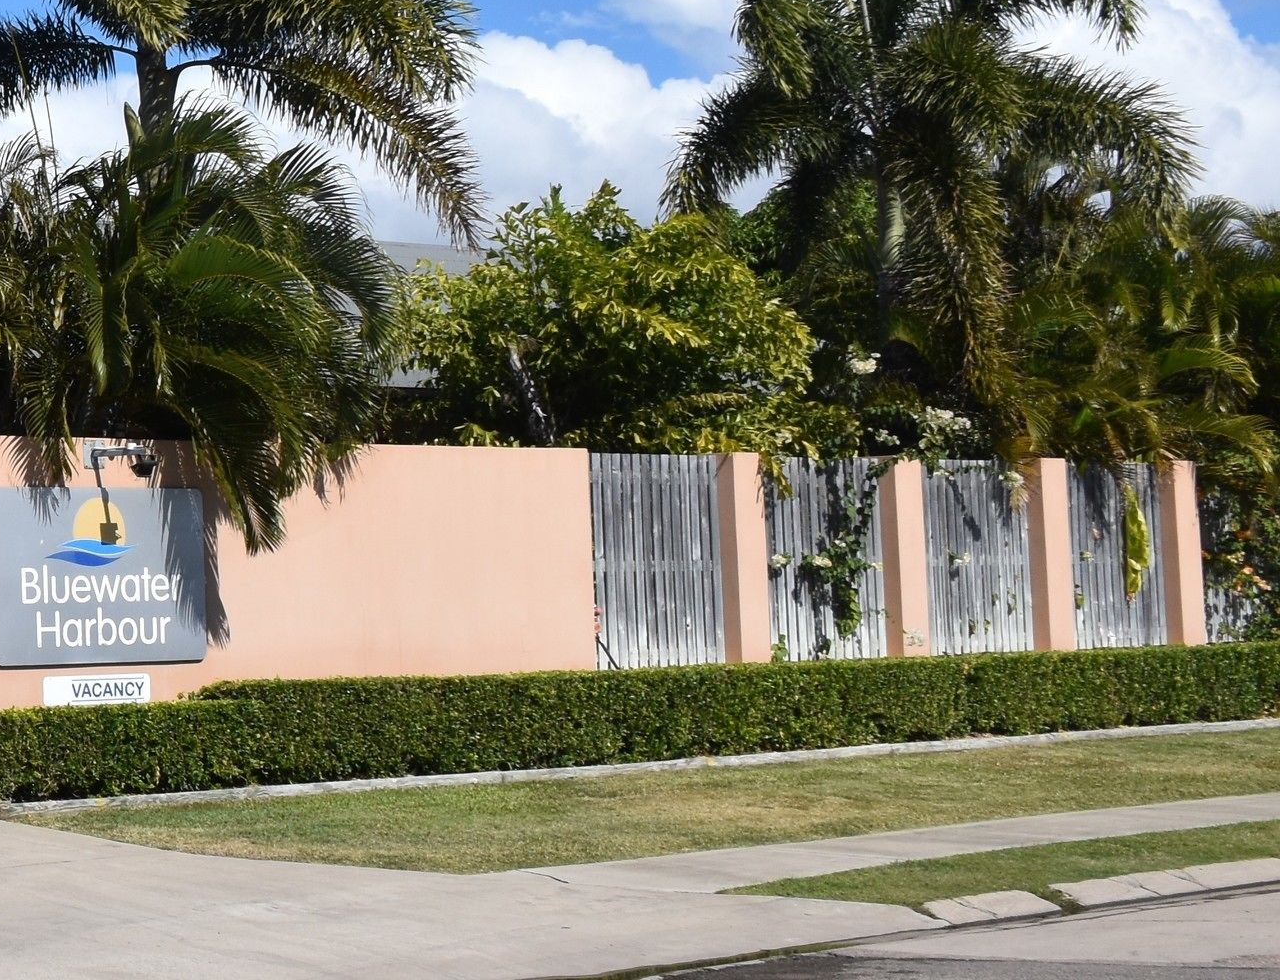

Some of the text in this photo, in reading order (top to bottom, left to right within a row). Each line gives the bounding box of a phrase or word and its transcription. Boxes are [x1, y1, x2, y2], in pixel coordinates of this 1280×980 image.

[20, 566, 182, 605] Bluewater
[36, 607, 171, 649] Harbour
[72, 681, 145, 698] VACANCY
